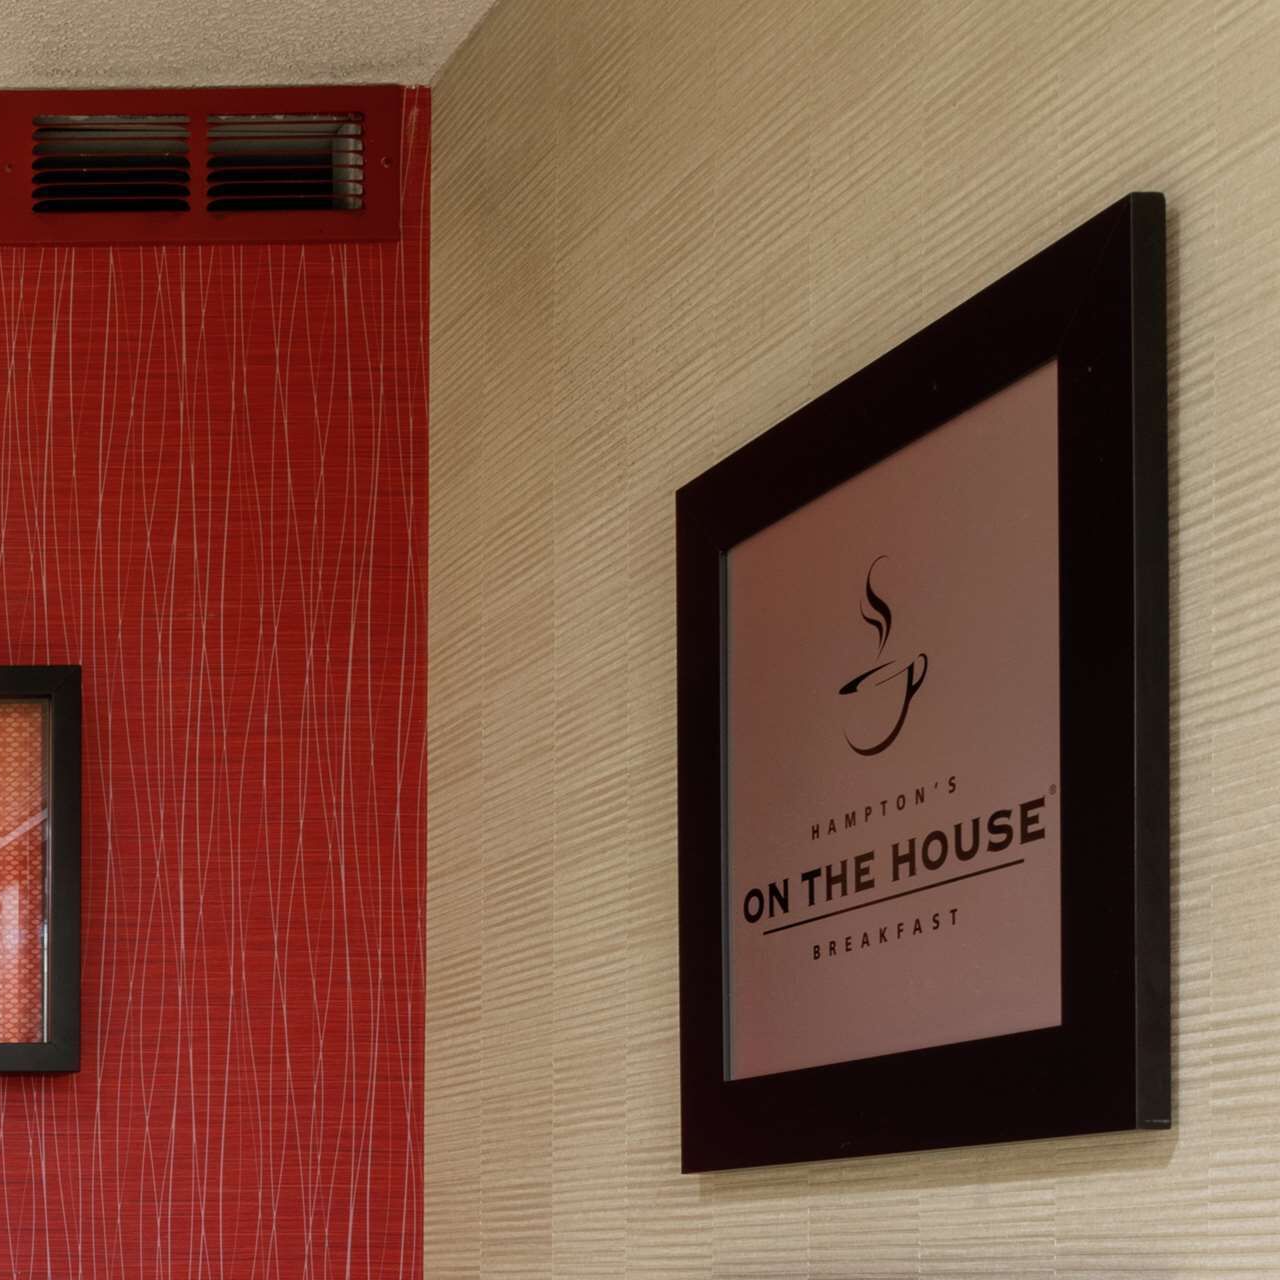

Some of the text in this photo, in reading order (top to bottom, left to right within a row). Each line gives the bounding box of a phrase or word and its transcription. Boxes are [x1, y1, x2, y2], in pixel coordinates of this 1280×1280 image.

[811, 776, 957, 840] HAMPTON'S
[743, 878, 789, 924] ON
[801, 850, 875, 907] THE
[813, 909, 958, 960] BREAKFAST
